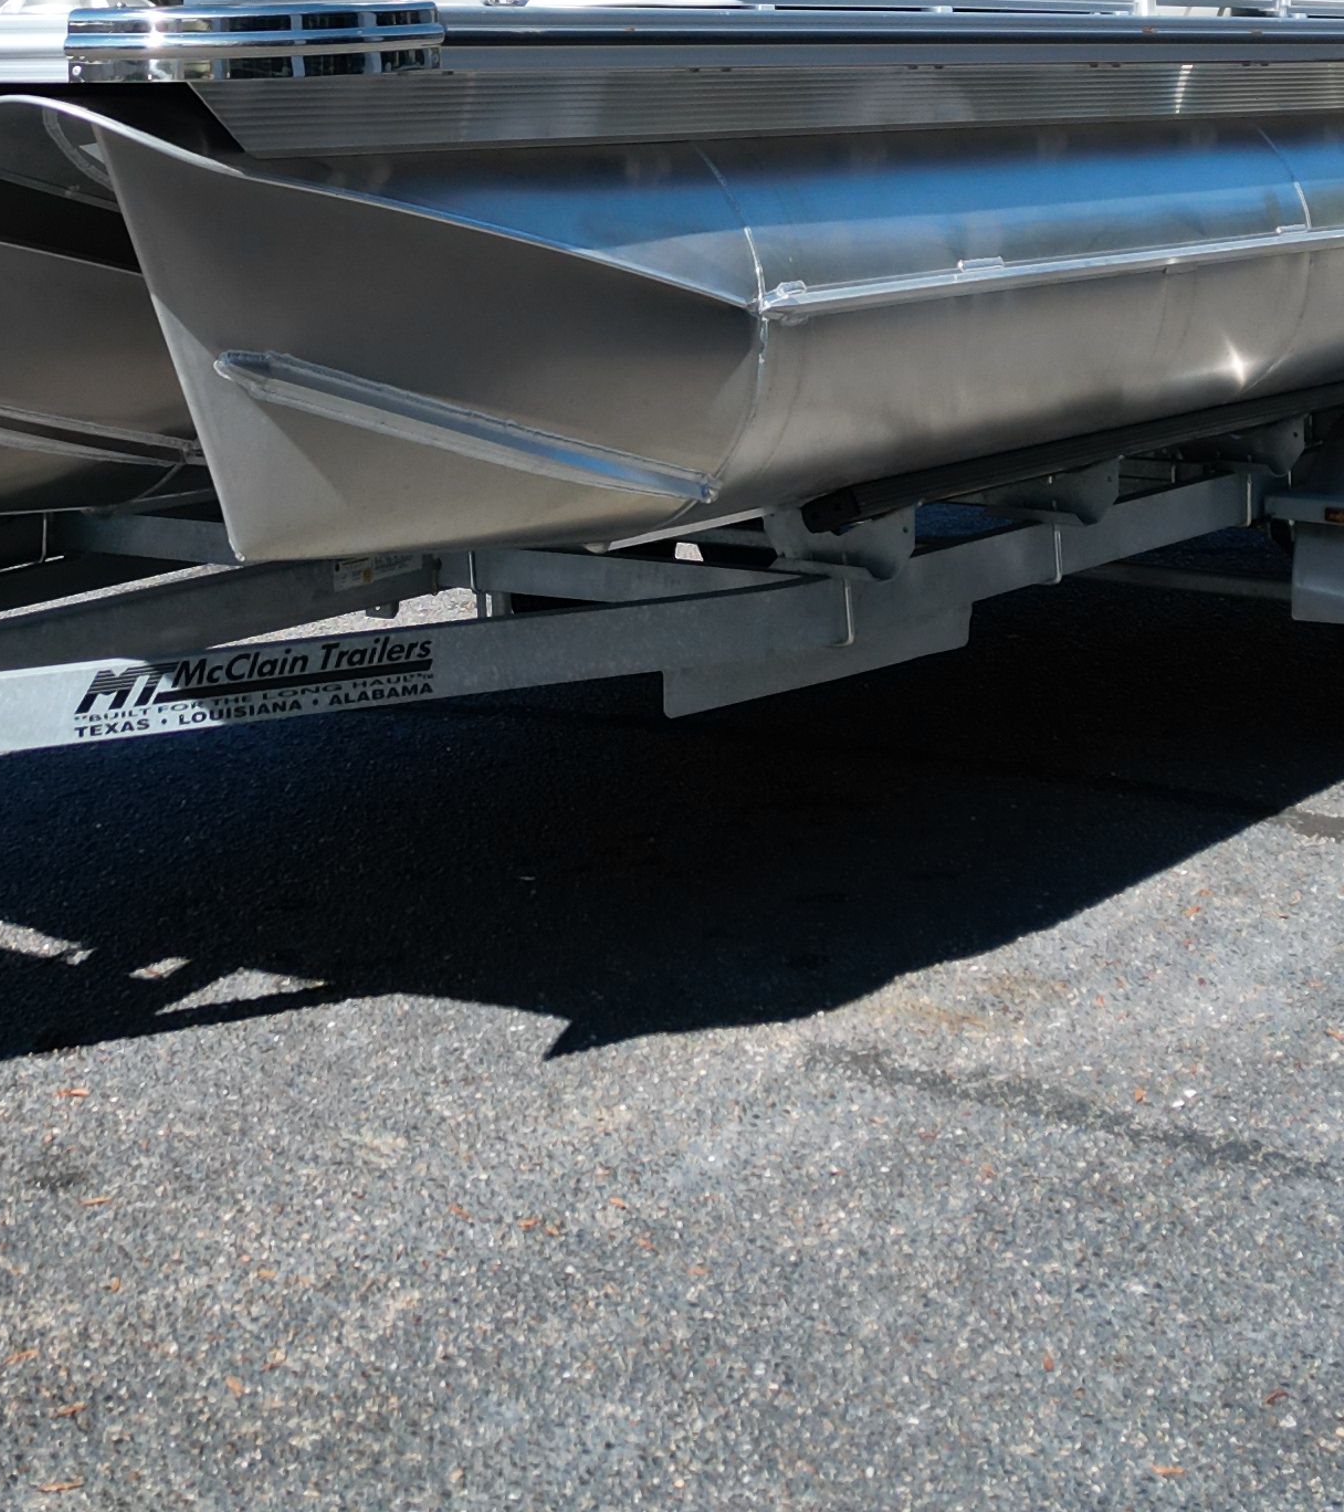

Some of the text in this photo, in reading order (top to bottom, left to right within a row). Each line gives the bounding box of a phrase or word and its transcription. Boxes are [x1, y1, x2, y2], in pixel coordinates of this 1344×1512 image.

[171, 647, 309, 690] McClain
[320, 635, 433, 671] Trailers
[74, 682, 434, 739] TEXAS LOUISIANA ALABAMA
[158, 700, 205, 714] FOR
[211, 694, 253, 706] THE
[261, 683, 343, 701] LONG
